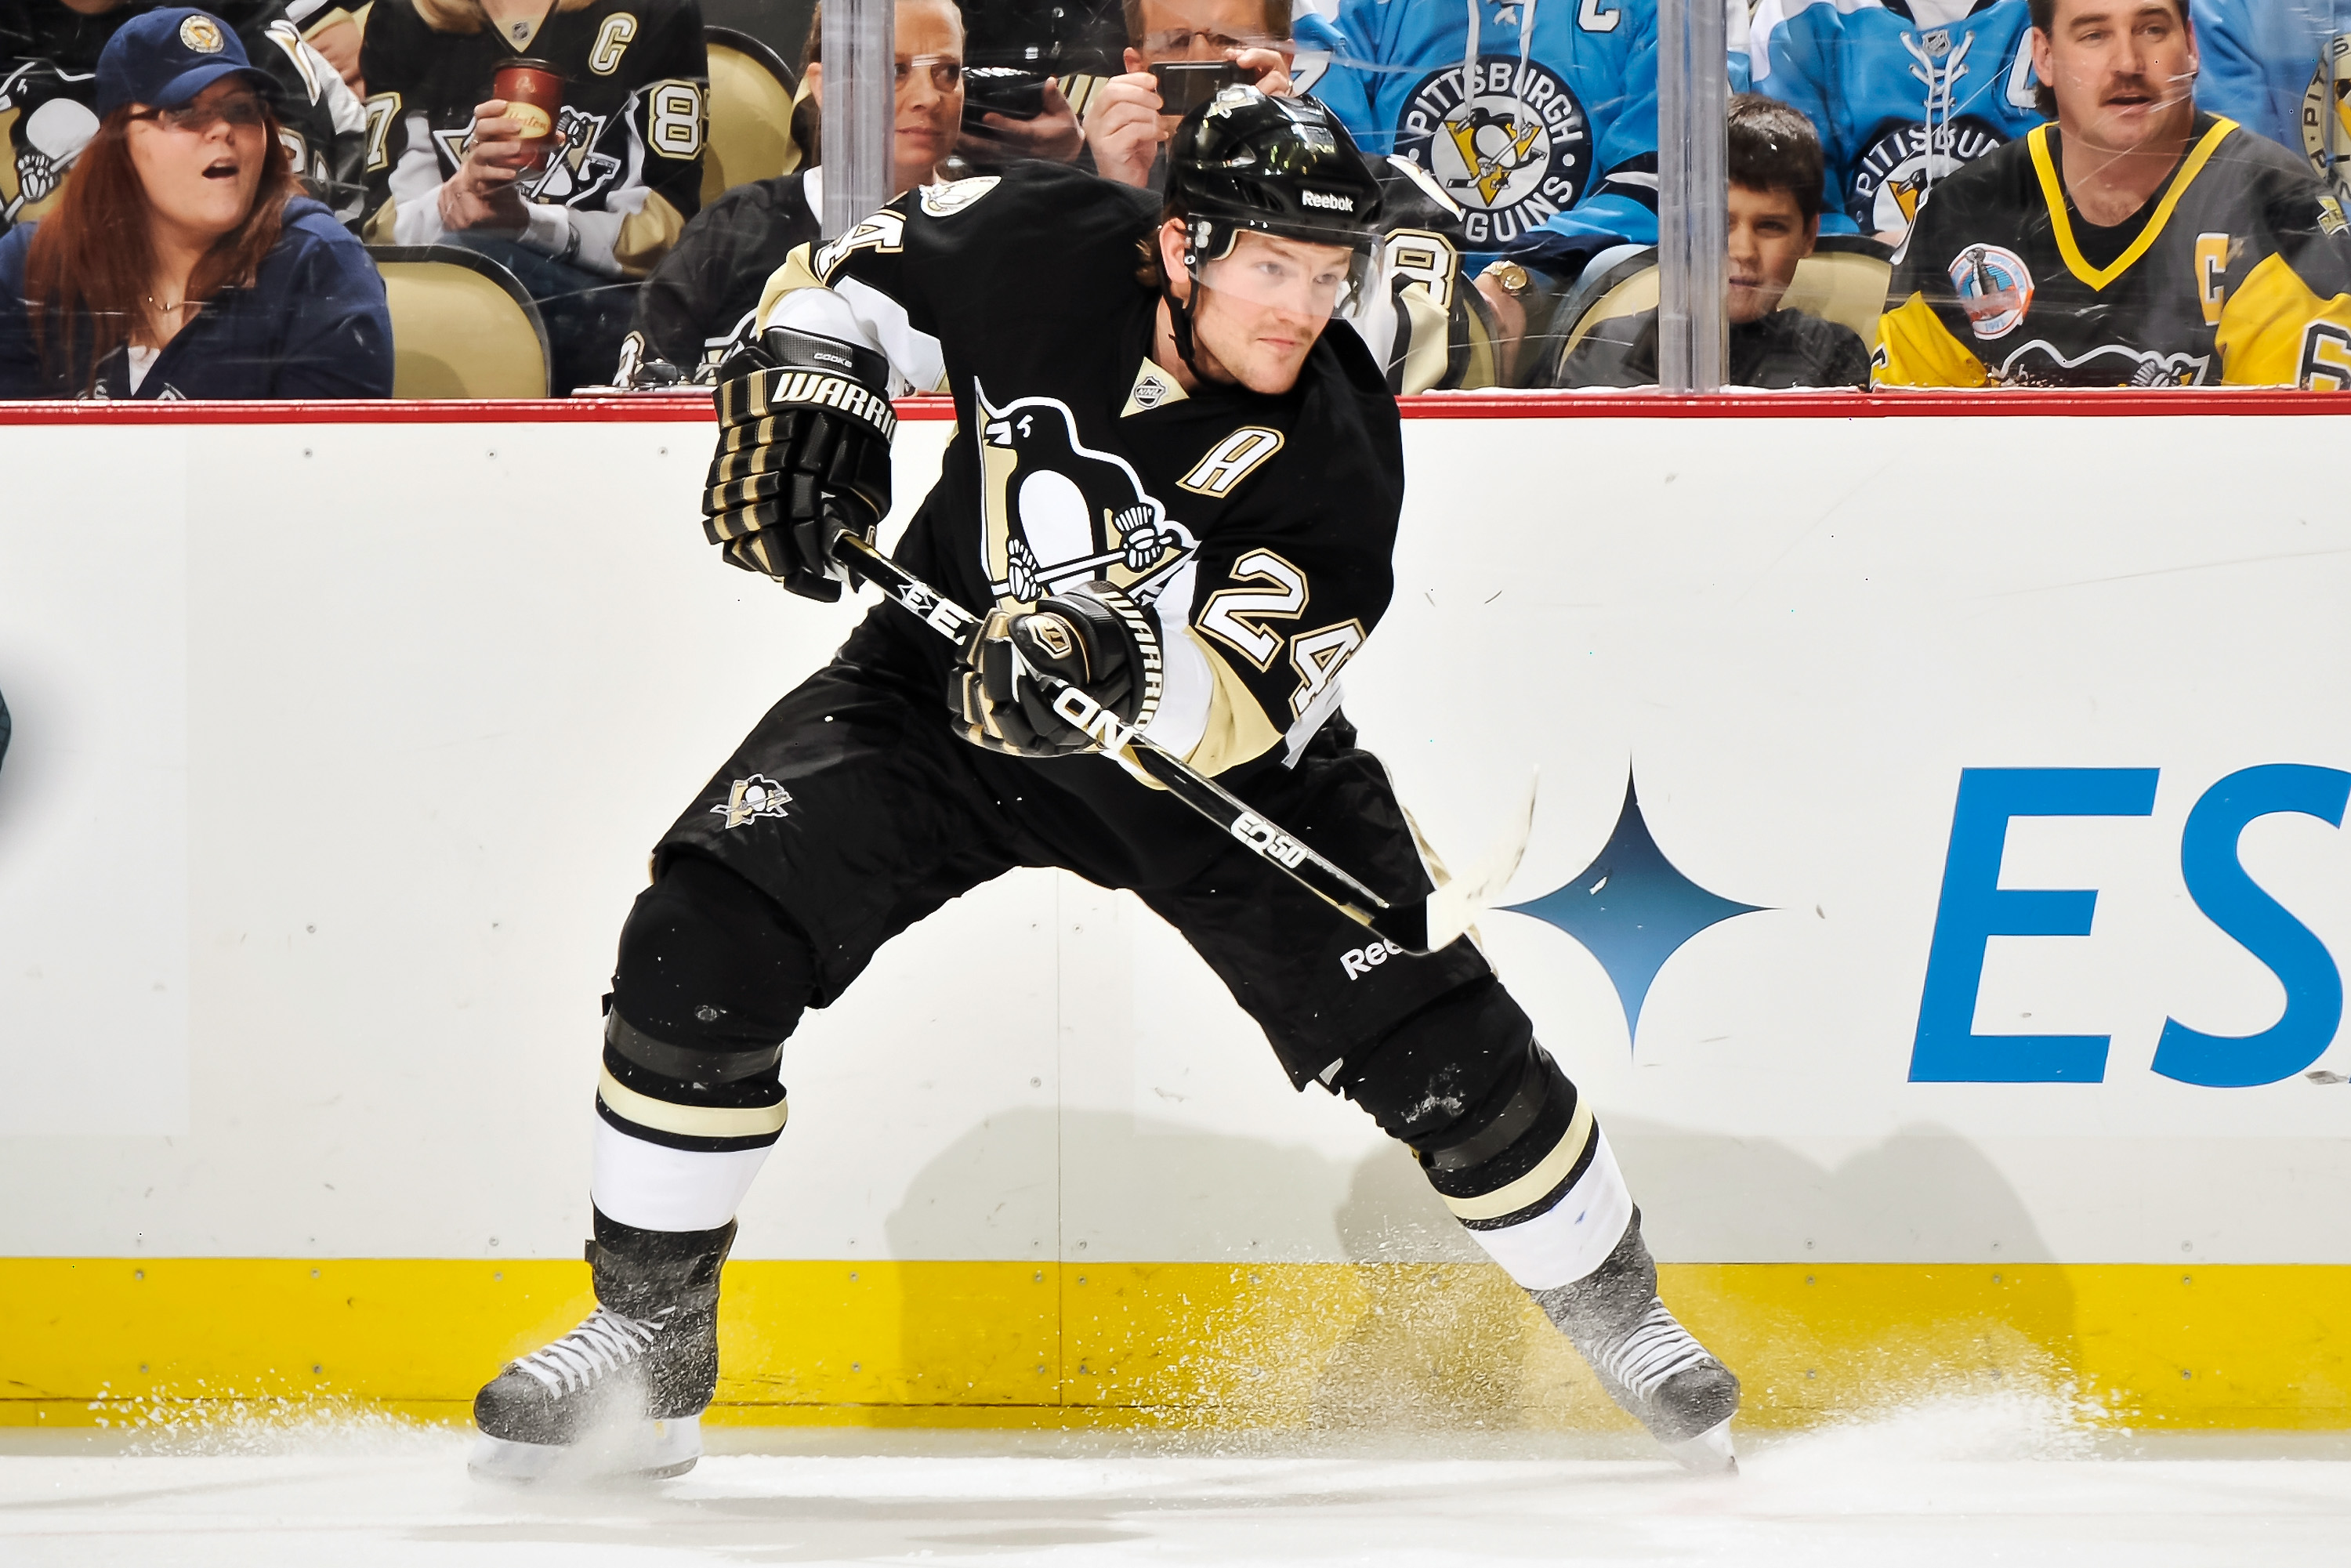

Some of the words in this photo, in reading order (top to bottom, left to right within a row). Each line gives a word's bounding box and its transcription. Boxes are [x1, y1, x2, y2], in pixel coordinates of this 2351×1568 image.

[589, 12, 637, 76] C
[1406, 62, 1584, 145] PITTSBURGH
[1302, 190, 1354, 212] Reebok
[1459, 176, 1574, 243] GUINS
[1176, 425, 1285, 498] A
[1194, 547, 1367, 722] 24
[1339, 937, 1405, 981] Ree
[1907, 762, 2351, 1088] ES
